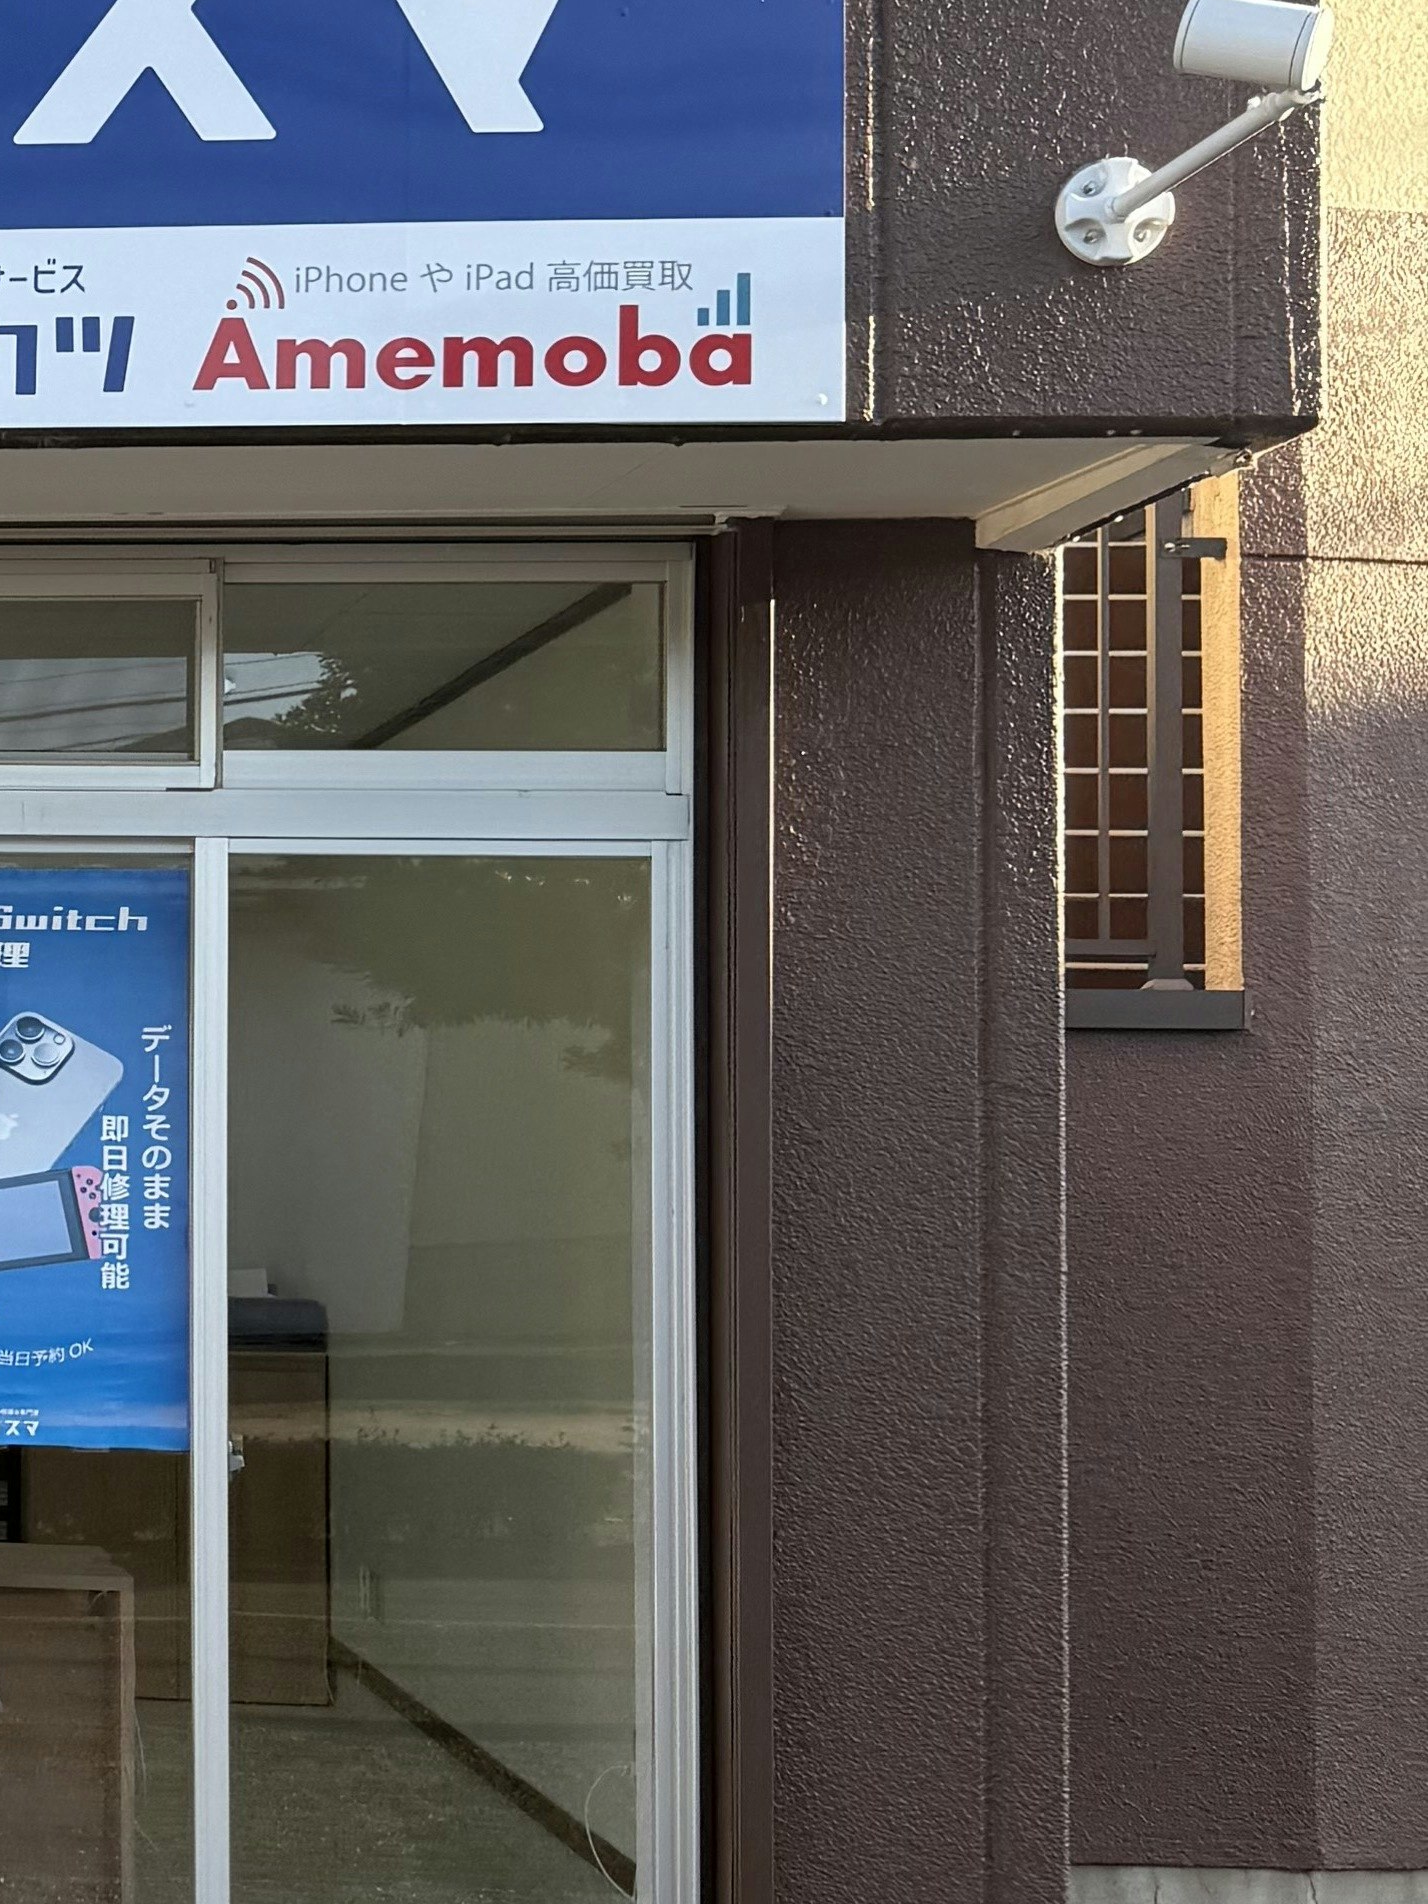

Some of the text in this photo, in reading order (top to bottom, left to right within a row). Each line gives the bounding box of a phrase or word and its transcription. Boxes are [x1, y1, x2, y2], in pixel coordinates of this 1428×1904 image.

[295, 259, 693, 294] iPhone や iPad 高価買取
[193, 303, 752, 391] Amemoba
[141, 1024, 172, 1229] データそのまま
[100, 1115, 130, 1290] 即日修理可能
